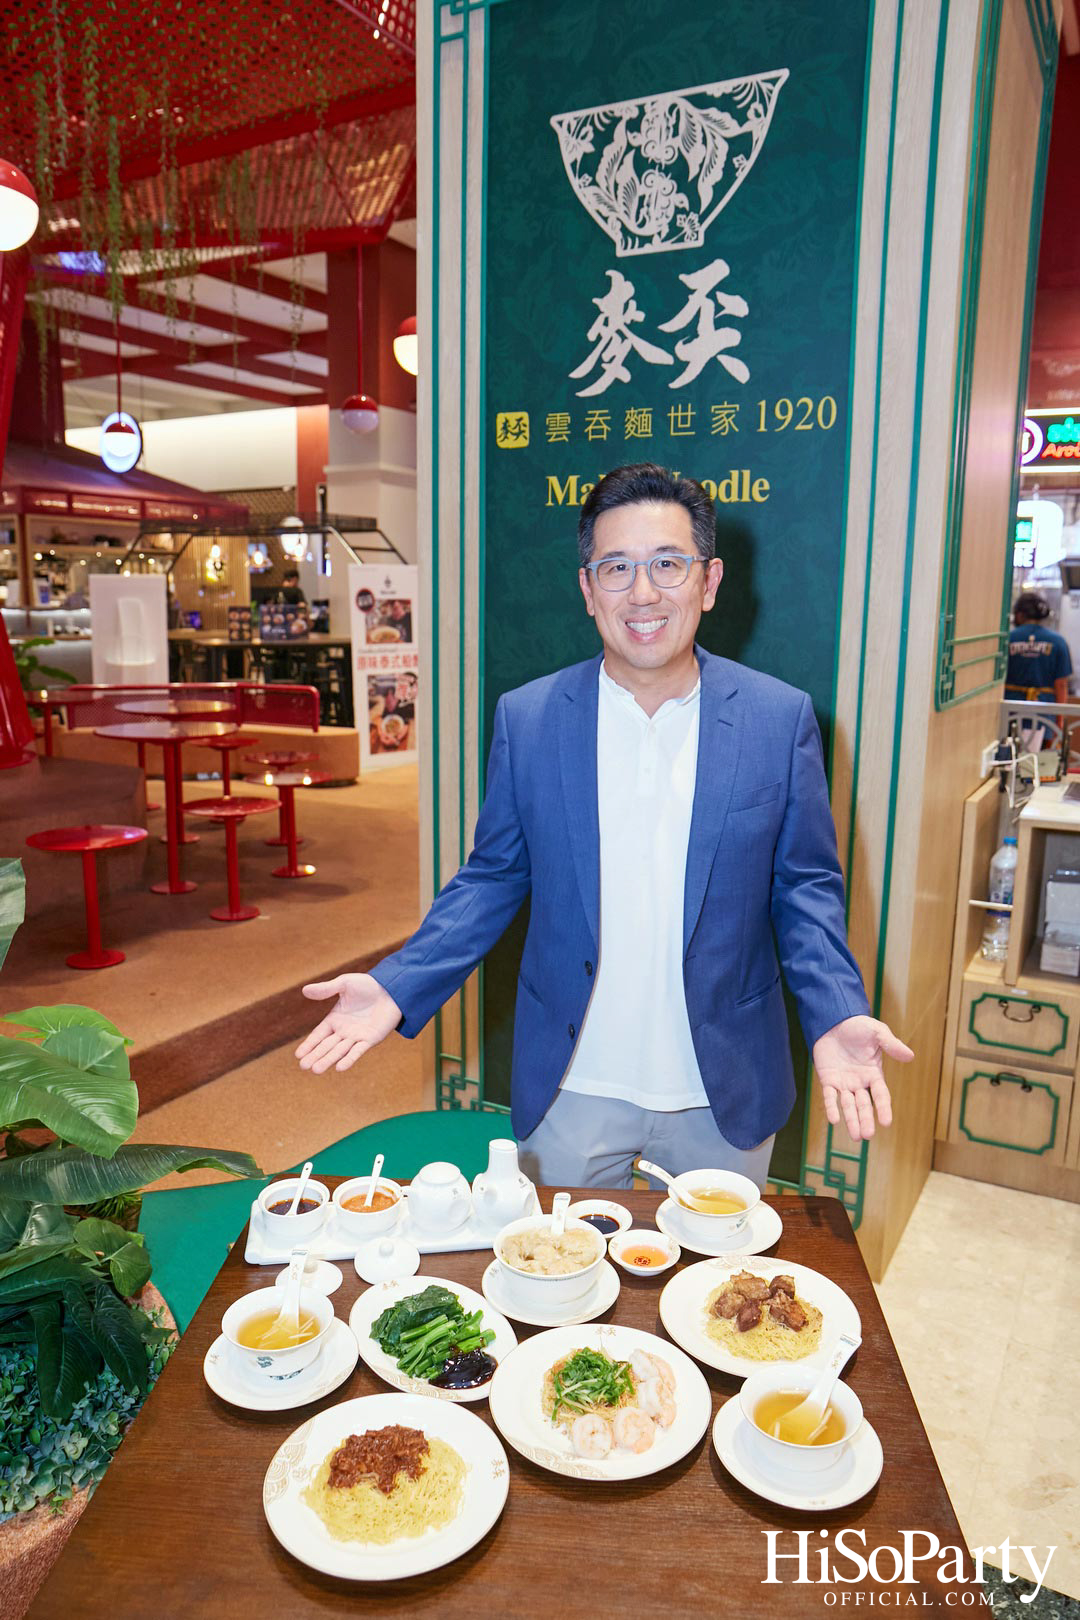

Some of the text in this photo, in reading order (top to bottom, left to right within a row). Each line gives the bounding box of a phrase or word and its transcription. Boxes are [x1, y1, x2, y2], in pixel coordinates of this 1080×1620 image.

[545, 401, 740, 442] 雲吞麵世家
[756, 396, 838, 433] 1920
